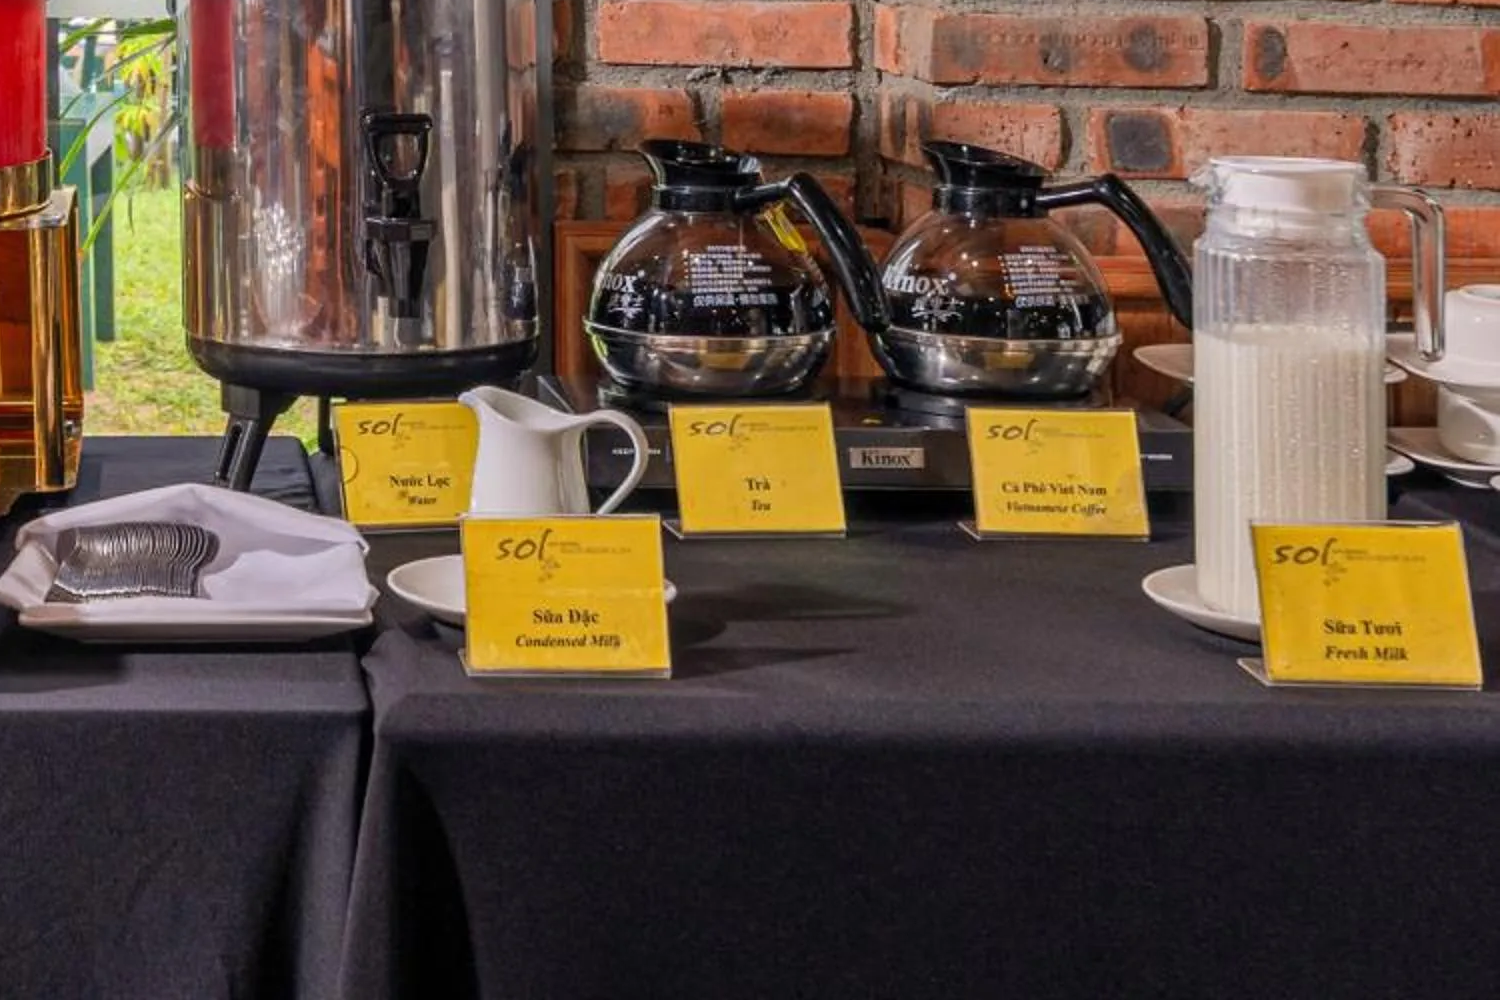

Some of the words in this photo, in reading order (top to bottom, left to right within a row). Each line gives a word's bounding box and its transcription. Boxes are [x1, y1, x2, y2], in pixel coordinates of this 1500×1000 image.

[861, 449, 912, 467] Kinox
[515, 633, 587, 648] Condensed
[1325, 645, 1369, 660] Fresh
[1373, 645, 1409, 661] Milk
